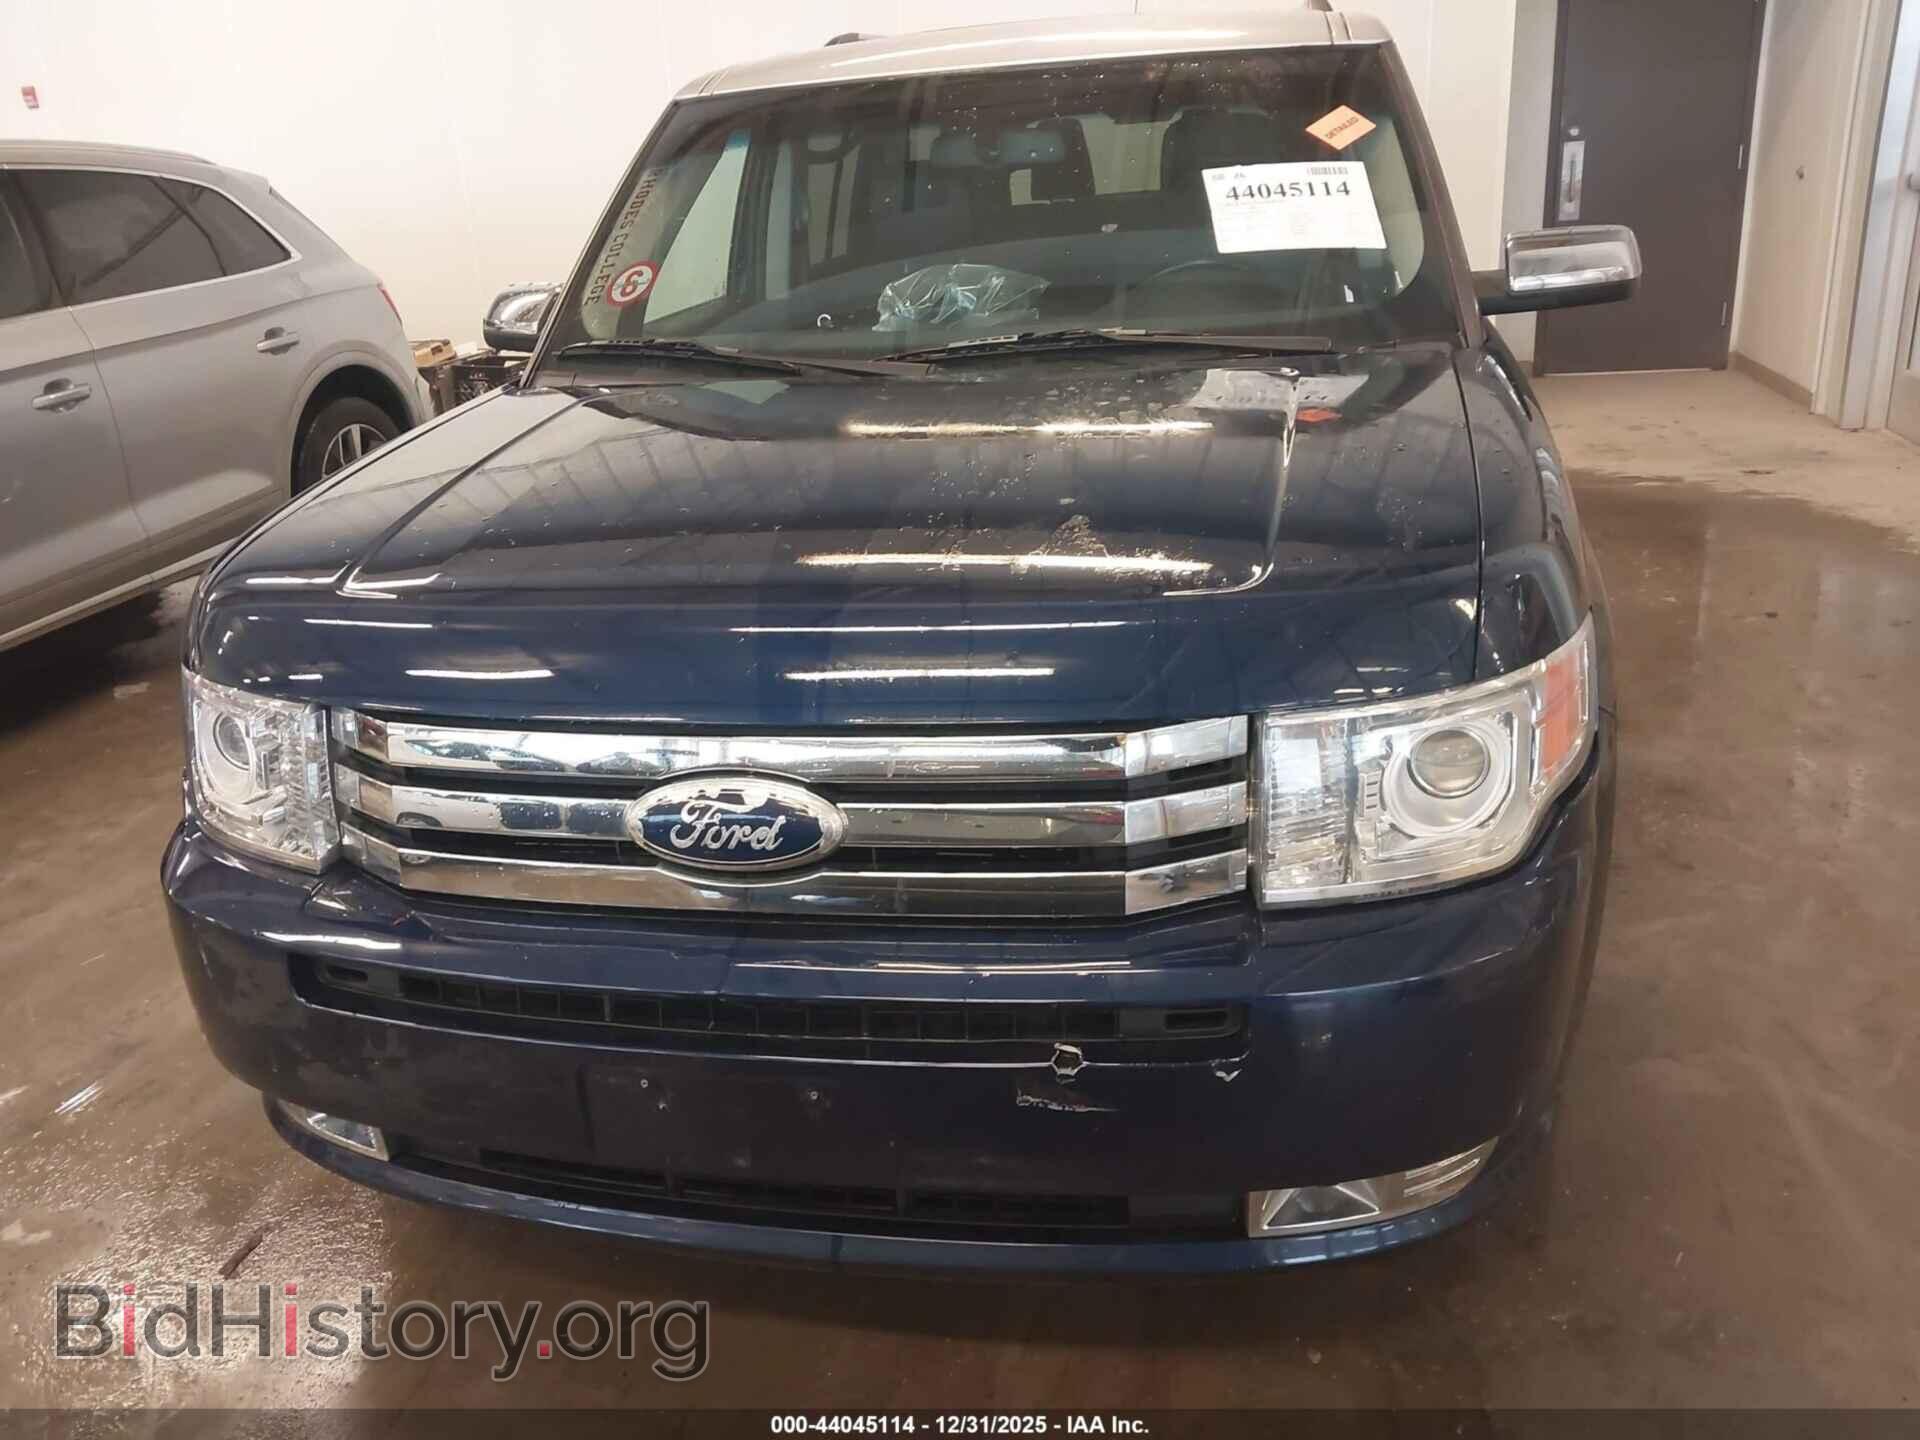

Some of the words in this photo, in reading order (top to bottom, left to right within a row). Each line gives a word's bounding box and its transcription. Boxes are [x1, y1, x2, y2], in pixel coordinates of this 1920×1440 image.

[1226, 181, 1351, 201] 44045114
[584, 232, 629, 306] COLLEGE
[669, 799, 787, 851] Ford
